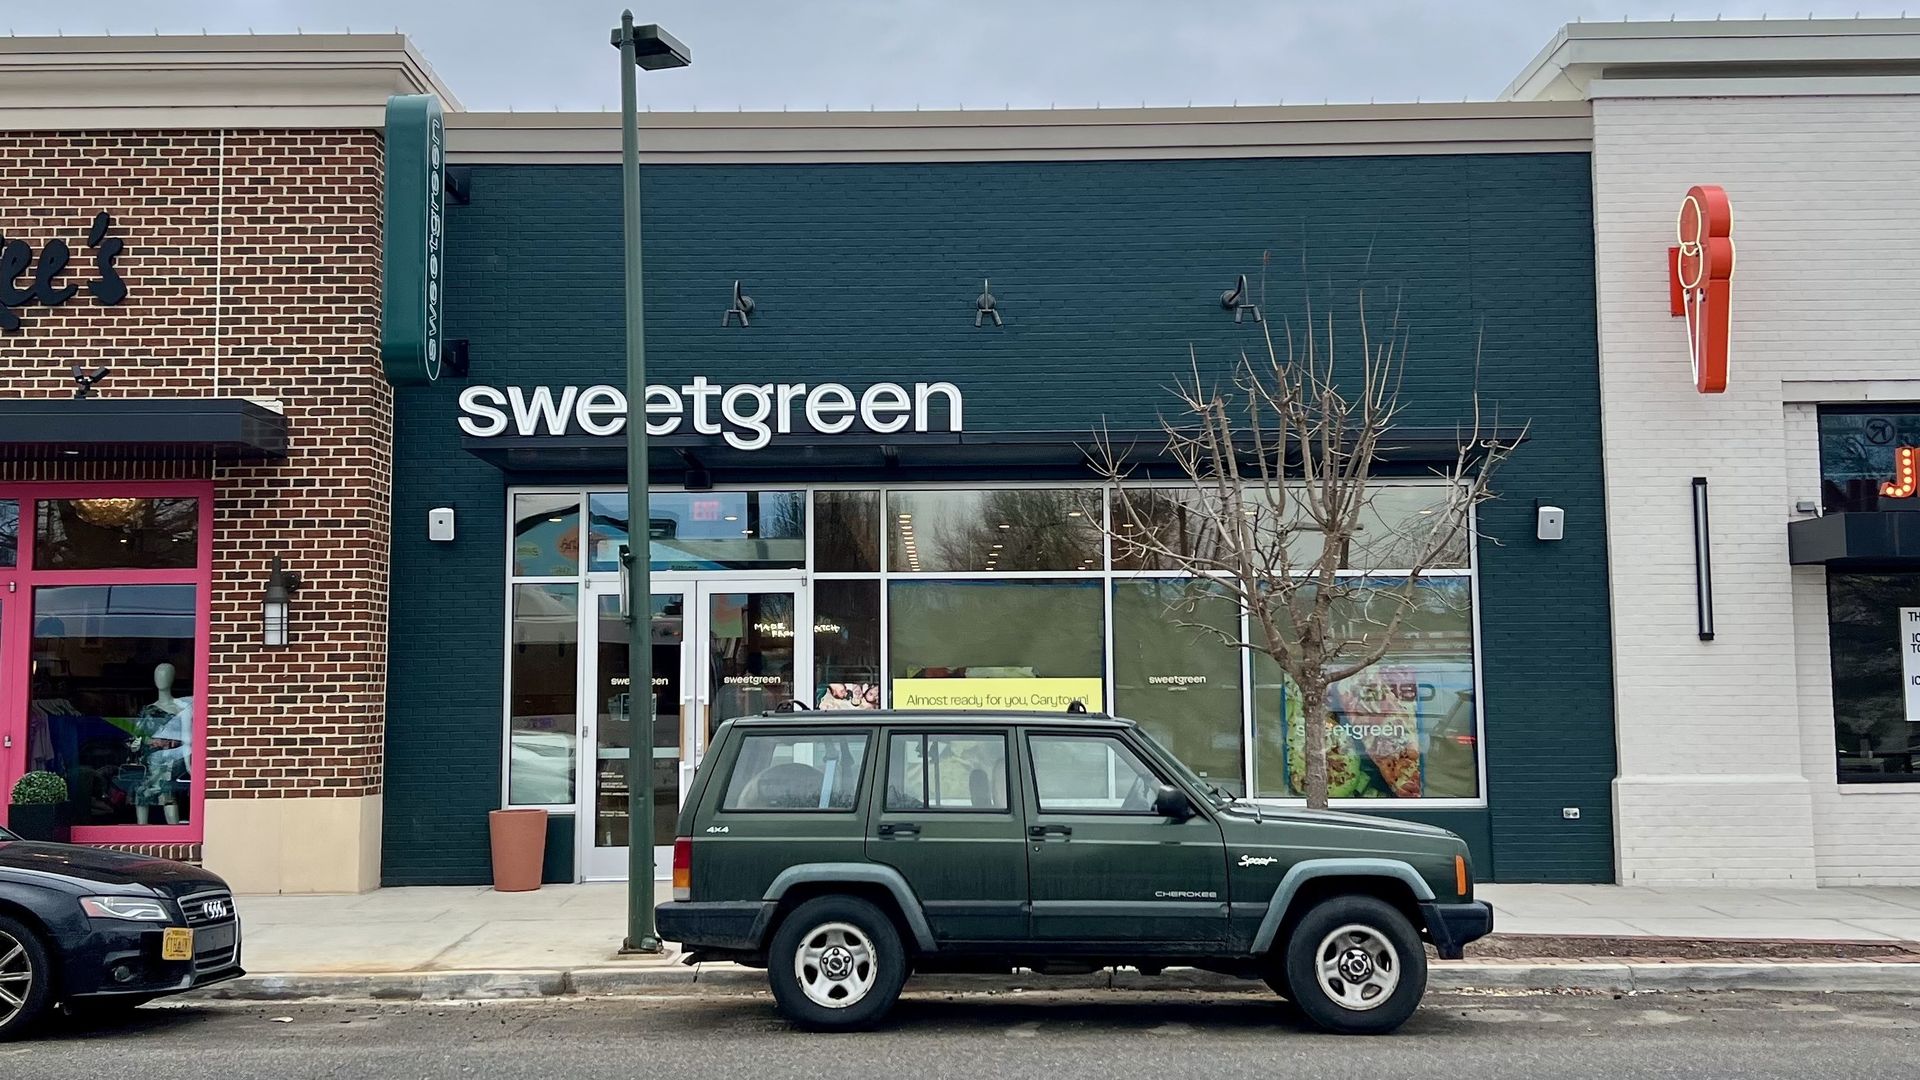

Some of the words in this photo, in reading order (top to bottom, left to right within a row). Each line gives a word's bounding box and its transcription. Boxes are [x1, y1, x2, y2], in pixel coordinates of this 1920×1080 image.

[429, 118, 440, 362] sweetgreen
[0, 211, 128, 331] ee's
[457, 376, 963, 450] sweetgreen
[1879, 447, 1920, 498] J
[610, 677, 669, 686] sweeen
[723, 675, 781, 686] sweetgreen
[1148, 675, 1207, 686] sweetgreen
[907, 694, 947, 705] Almost
[951, 694, 983, 707] ready
[986, 694, 1002, 705] for
[1004, 696, 1028, 708] you,
[1031, 694, 1089, 708] Carytown!
[1238, 854, 1278, 867] Sport
[1155, 890, 1217, 898] CHEROKEE
